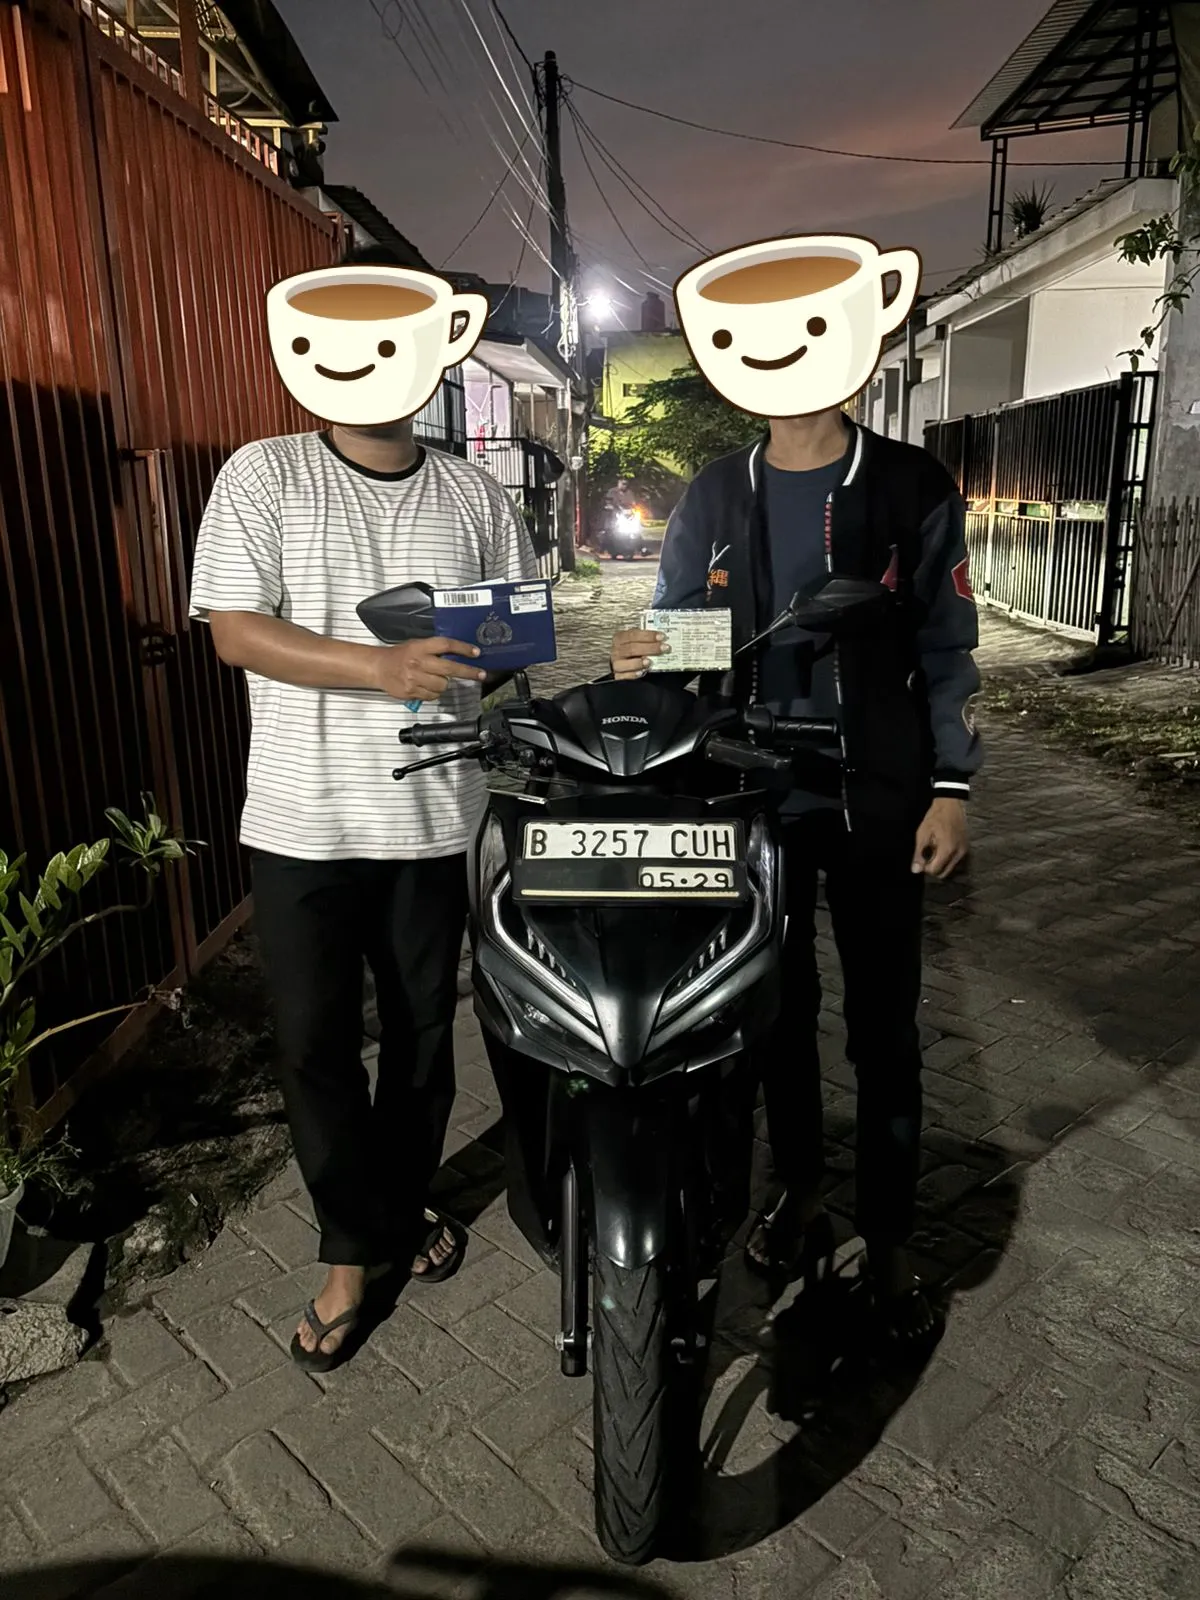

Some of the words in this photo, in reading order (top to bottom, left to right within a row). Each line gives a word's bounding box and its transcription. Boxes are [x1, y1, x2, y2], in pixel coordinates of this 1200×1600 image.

[601, 715, 649, 725] HONDA
[530, 829, 548, 856] B
[570, 829, 650, 857] 3257
[670, 829, 732, 858] CUH
